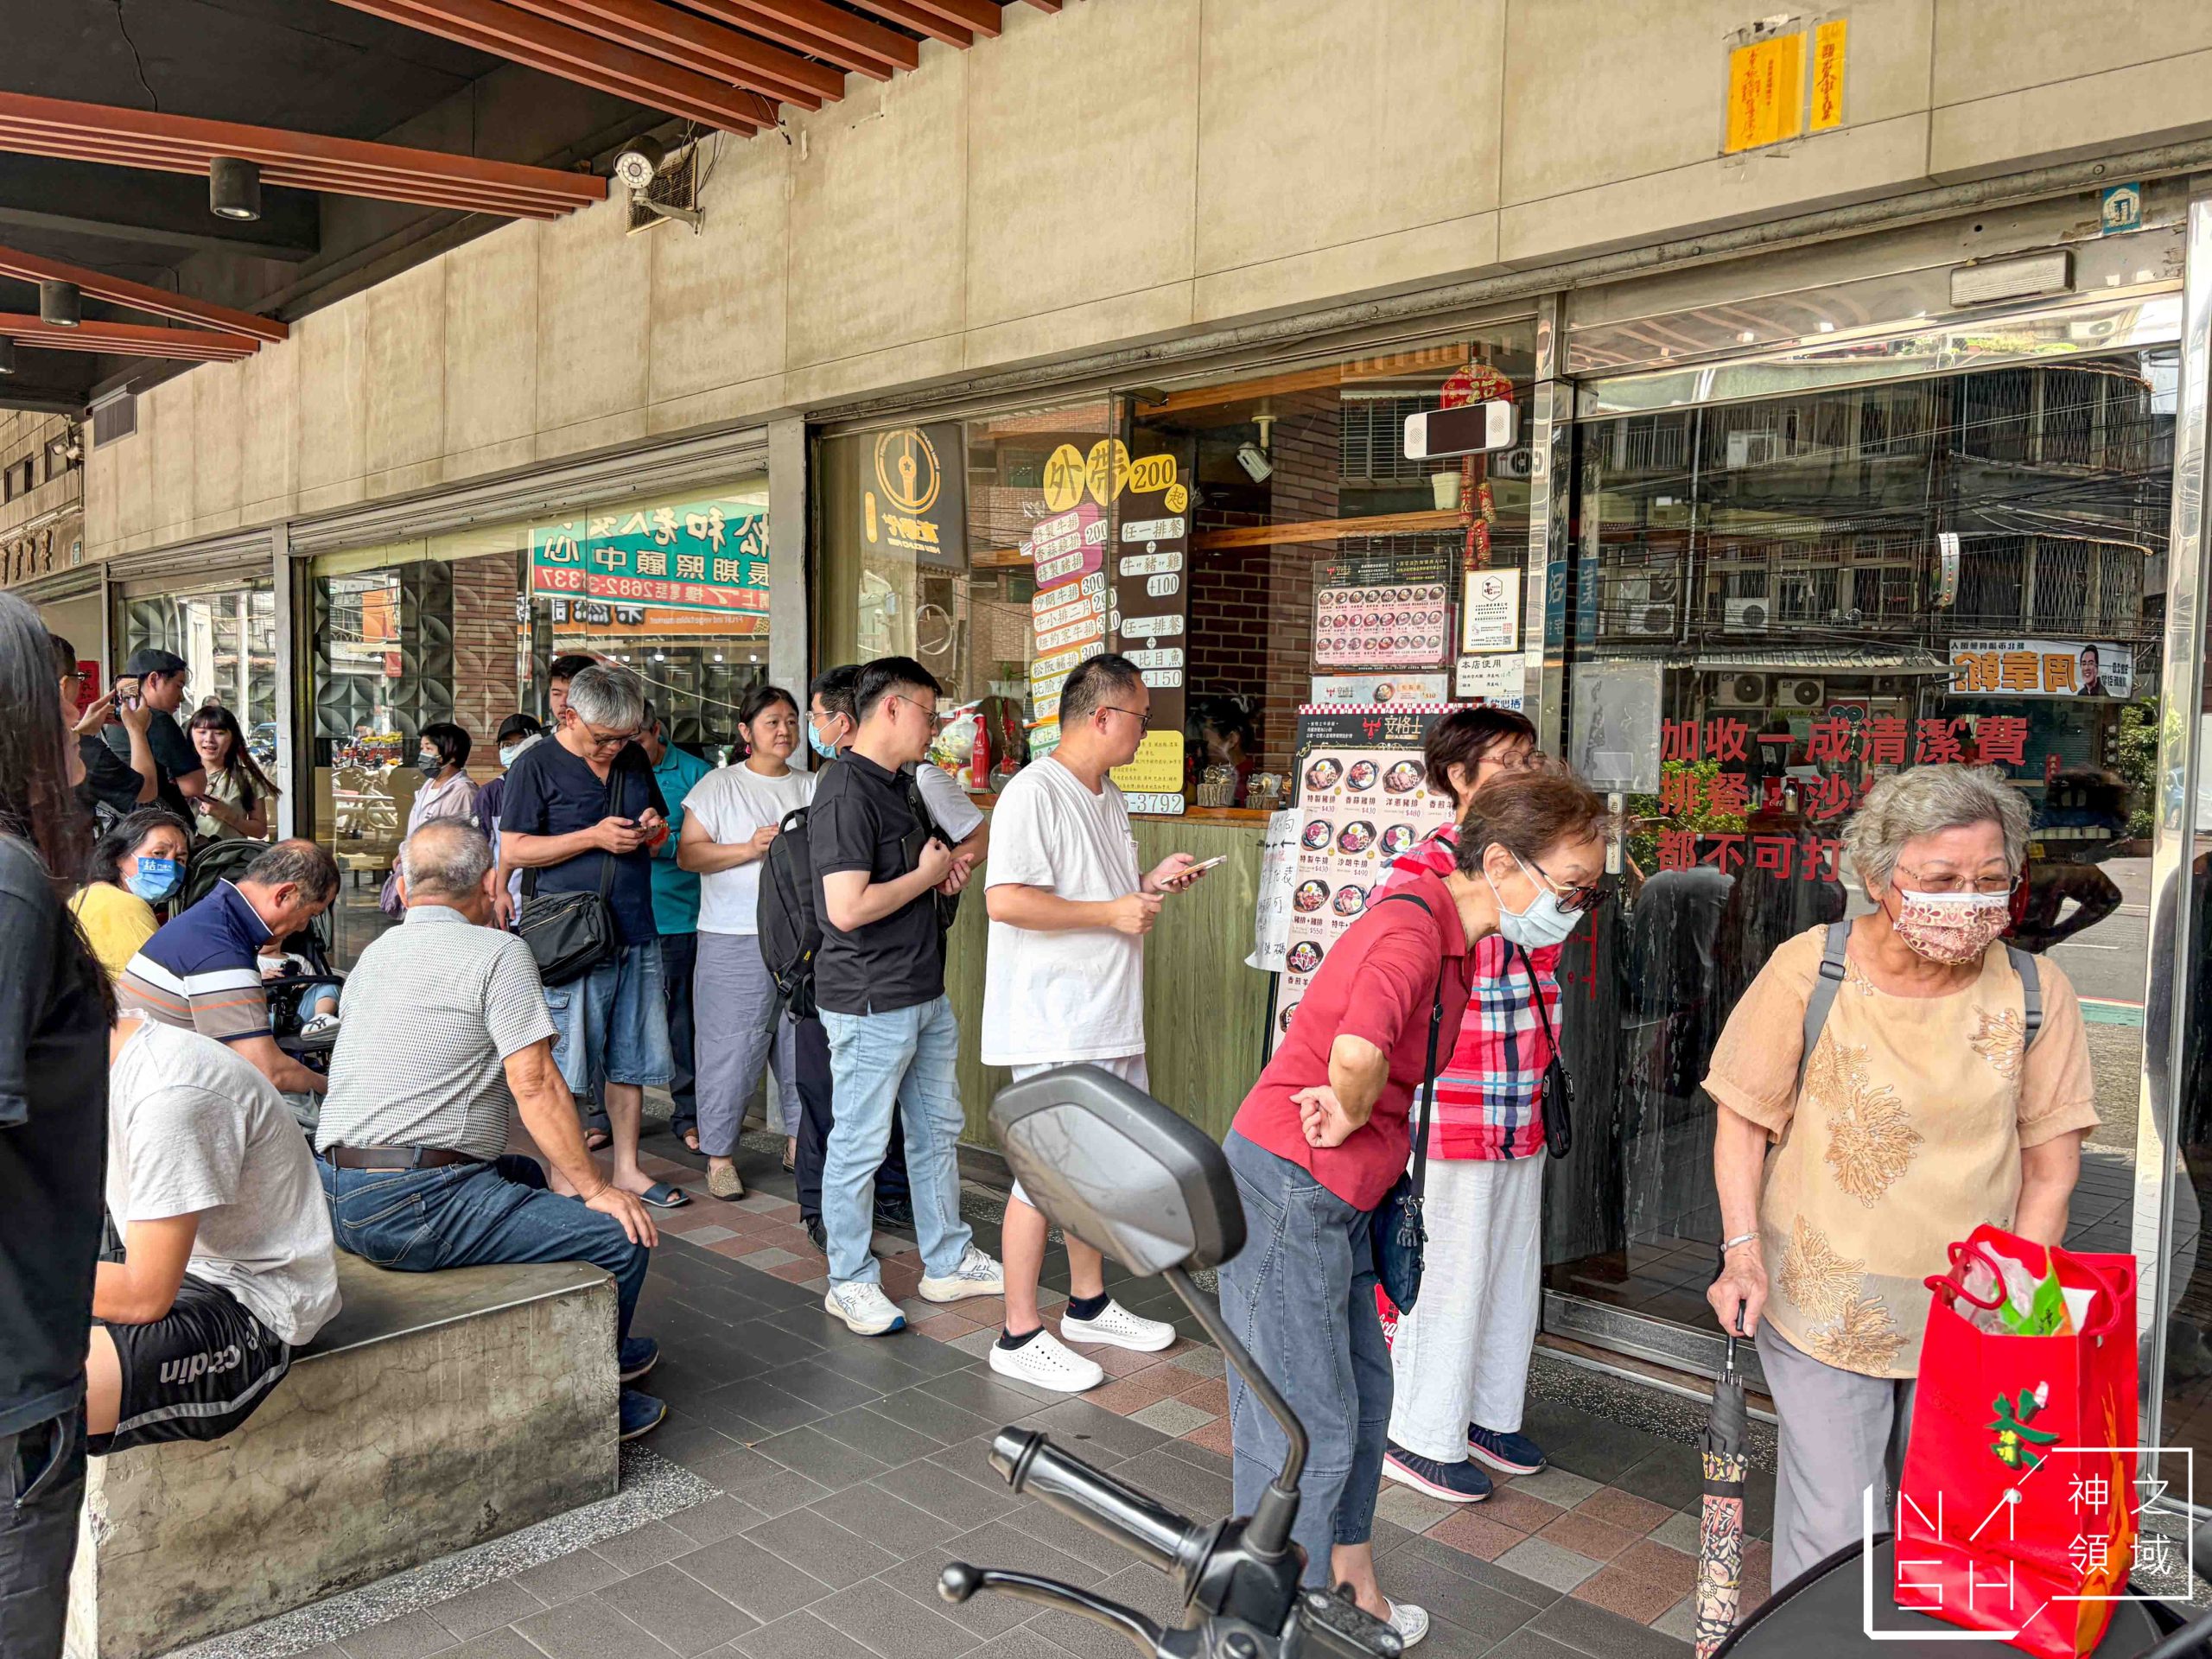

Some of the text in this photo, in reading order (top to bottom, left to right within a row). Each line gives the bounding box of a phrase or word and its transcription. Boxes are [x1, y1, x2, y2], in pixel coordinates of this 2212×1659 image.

[1049, 442, 1127, 508] 外帶
[1134, 459, 1173, 490] 200
[1125, 519, 1183, 542] 任一排餐
[1082, 575, 1103, 594] 300
[1149, 576, 1178, 594] +100
[1097, 613, 1120, 636] 30
[1123, 616, 1182, 636] 任一排餐
[1461, 659, 1501, 670] 本店使用
[1143, 671, 1181, 687] +150
[1384, 715, 1423, 734] 安格士
[1661, 716, 2029, 766] 加收一成清潔費
[1659, 772, 1873, 820] 排餐、沙
